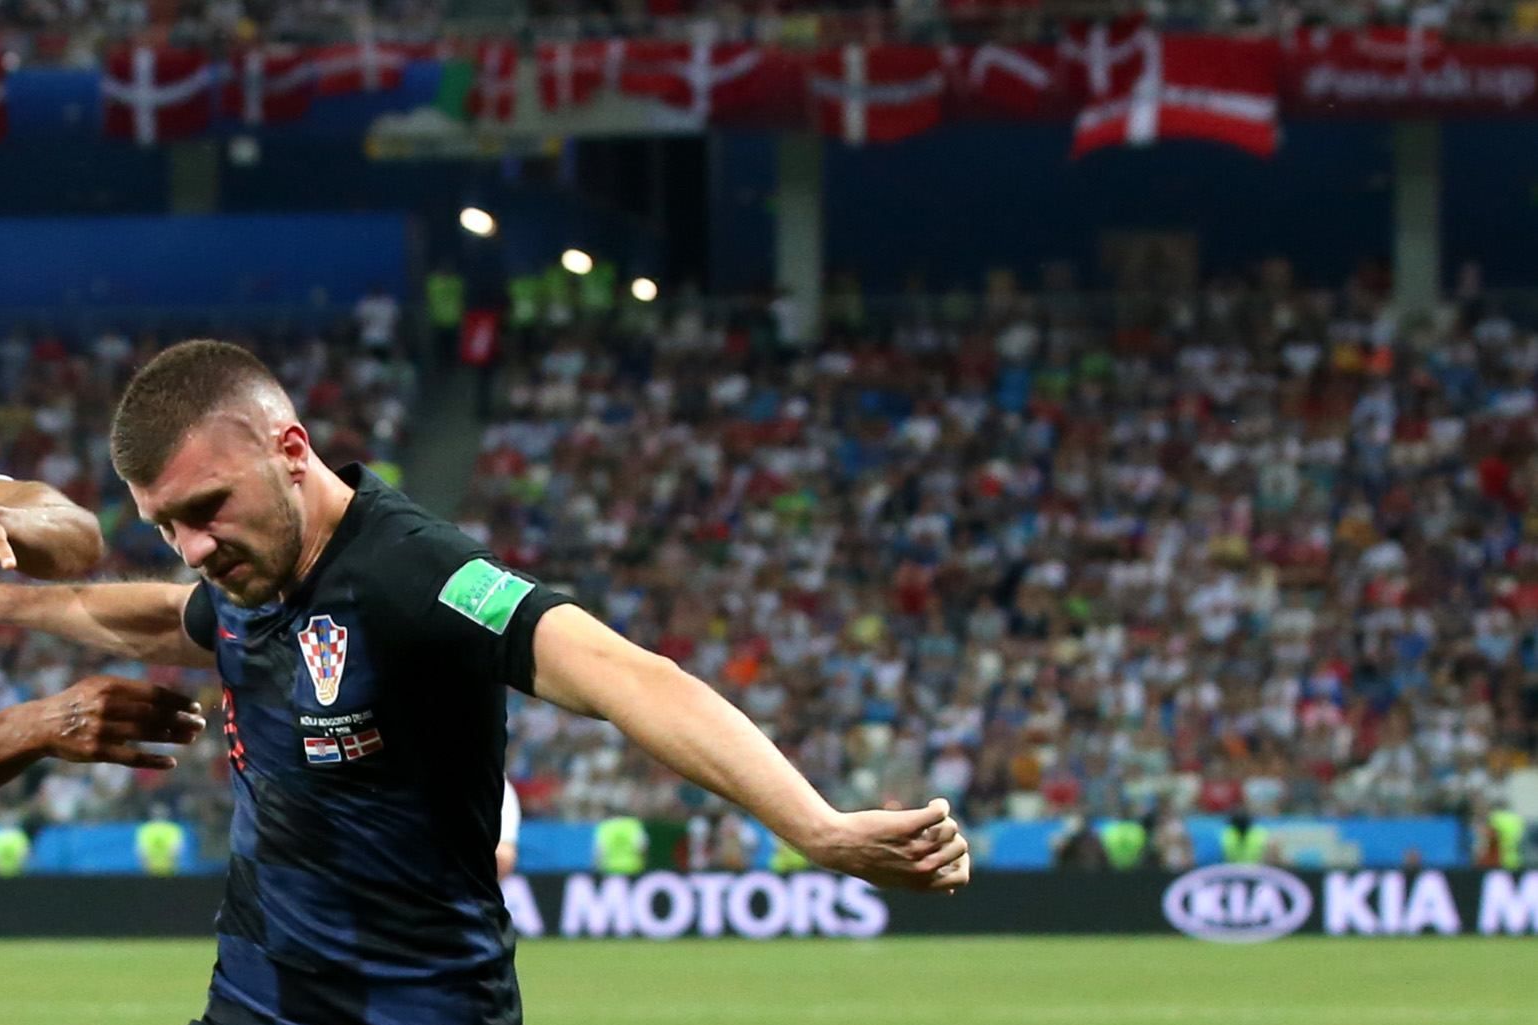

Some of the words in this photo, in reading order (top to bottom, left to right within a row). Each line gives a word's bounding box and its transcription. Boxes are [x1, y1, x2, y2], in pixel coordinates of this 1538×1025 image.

[559, 870, 891, 939] MOTORS
[1186, 885, 1287, 922] KIA
[1323, 870, 1460, 936] KIA
